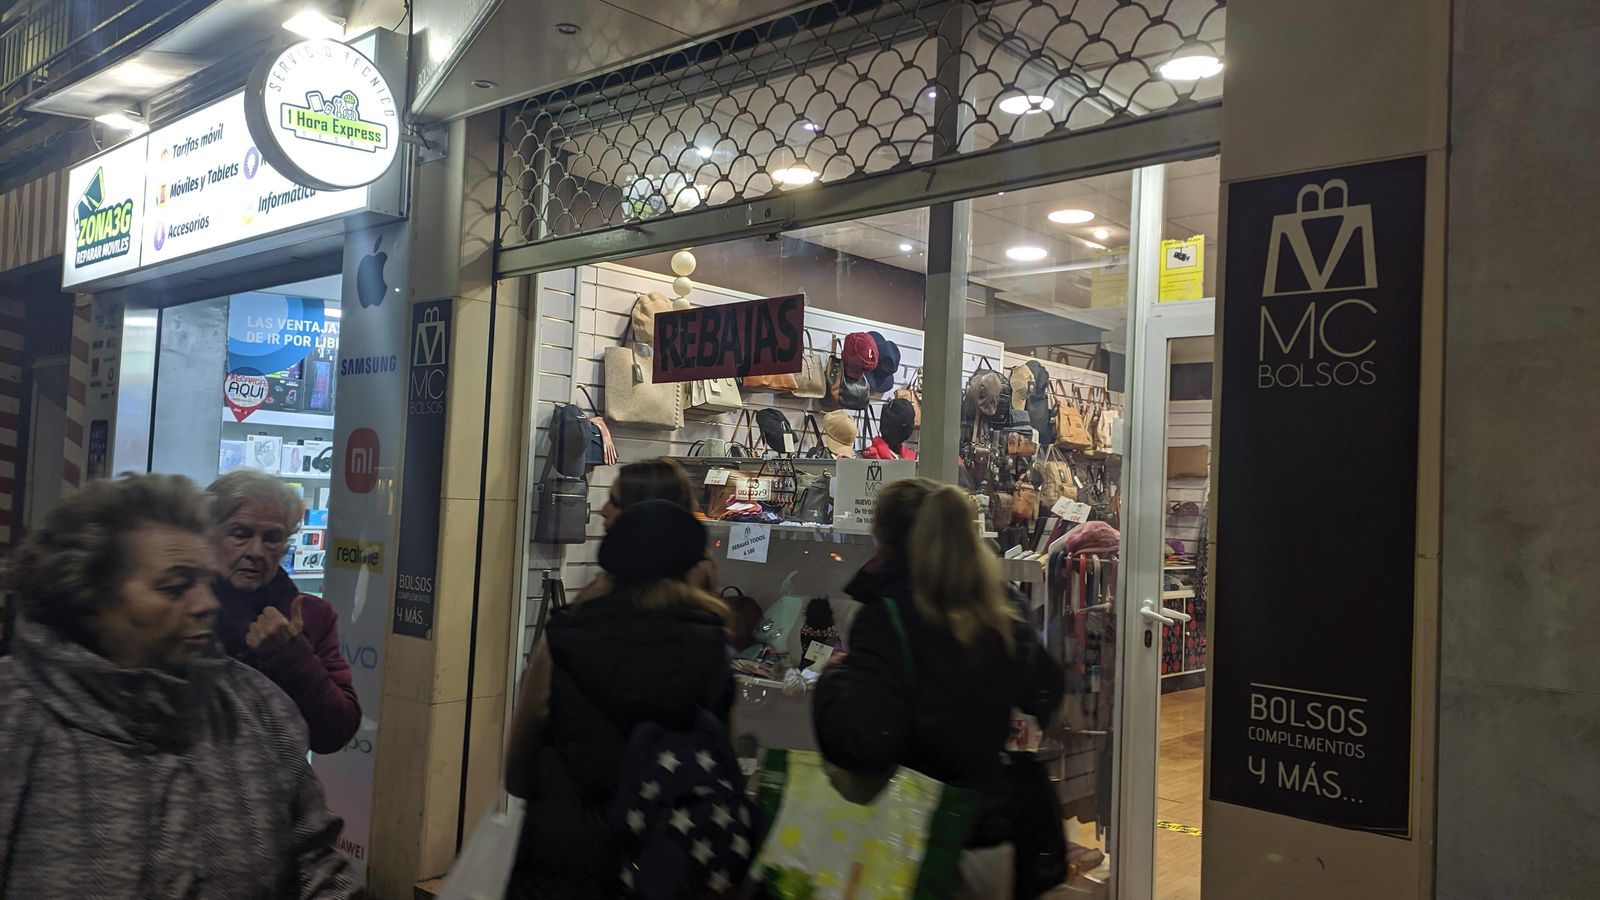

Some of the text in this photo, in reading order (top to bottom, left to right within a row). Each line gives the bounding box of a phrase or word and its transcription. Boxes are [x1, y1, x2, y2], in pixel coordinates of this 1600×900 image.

[269, 45, 332, 92] SERVICO
[173, 123, 224, 158] Tarifas móvil
[288, 109, 292, 124] 1
[297, 111, 328, 132] Hora
[333, 119, 381, 143] Express
[170, 162, 239, 199] Móviles y Tablets
[78, 202, 132, 247] ZONA3G
[168, 213, 209, 239] Accesorios
[76, 244, 102, 264] REPARAR
[246, 331, 263, 344] DE
[267, 332, 280, 345] IR
[284, 333, 311, 348] POR
[247, 316, 340, 335] LAS VENTAJA
[658, 297, 798, 377] REBAJAS
[1260, 298, 1378, 361] MC
[341, 355, 397, 376] SAMSUNG
[1258, 360, 1377, 388] BOLSOS
[410, 369, 445, 400] MC
[409, 401, 444, 415] BOLSOS
[750, 534, 766, 544] TODOS
[399, 574, 432, 592] BOLSOS
[1250, 693, 1368, 737] BOLSOS
[1248, 726, 1366, 759] COMPLEMENTOS
